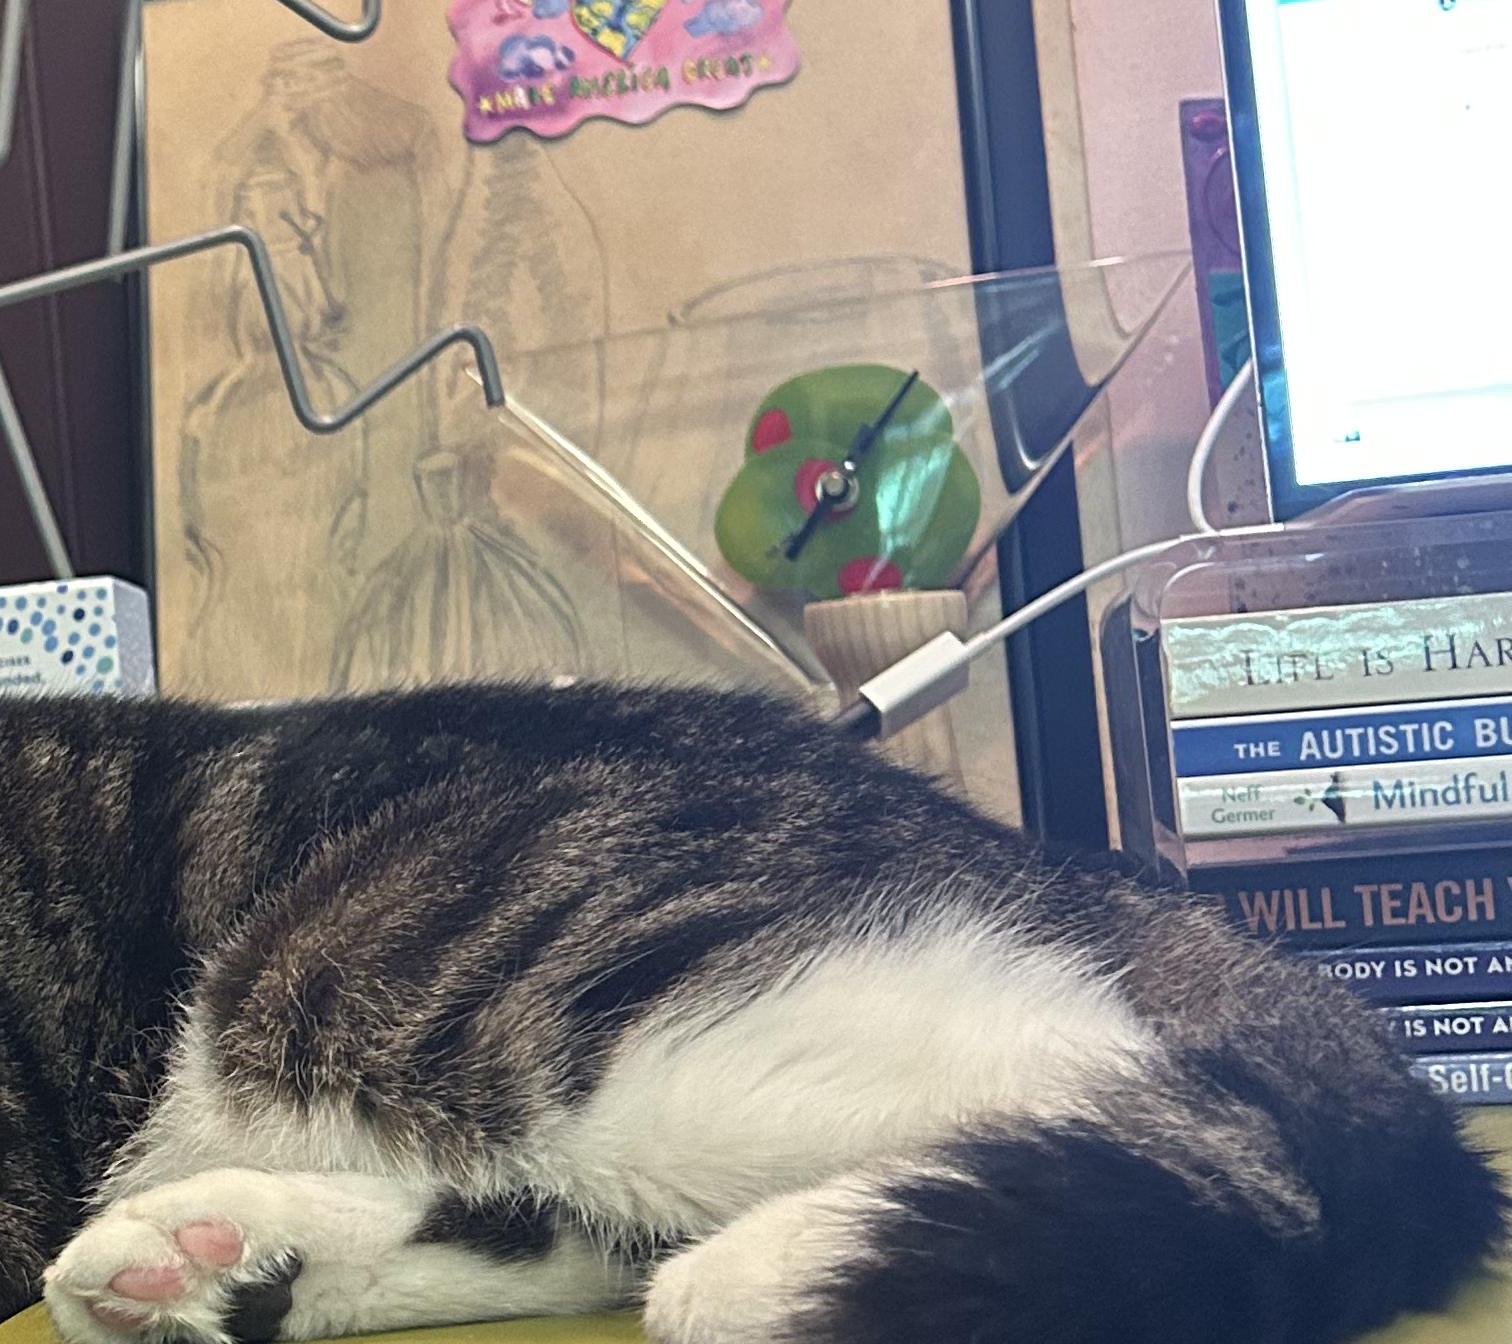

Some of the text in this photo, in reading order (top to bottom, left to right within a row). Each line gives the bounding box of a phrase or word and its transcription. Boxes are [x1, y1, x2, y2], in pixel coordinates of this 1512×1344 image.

[1234, 741, 1280, 759] THE
[1300, 721, 1454, 761] AUTISTIC
[1221, 783, 1263, 803] Neff
[1372, 770, 1510, 810] Mindful
[1211, 806, 1276, 824] Germer
[1238, 887, 1346, 933] WILL
[1353, 878, 1495, 928] TEACH
[1394, 959, 1418, 978] IS
[1425, 957, 1478, 976] NOT
[1404, 1019, 1427, 1037] IS
[1434, 1017, 1484, 1036] NOT
